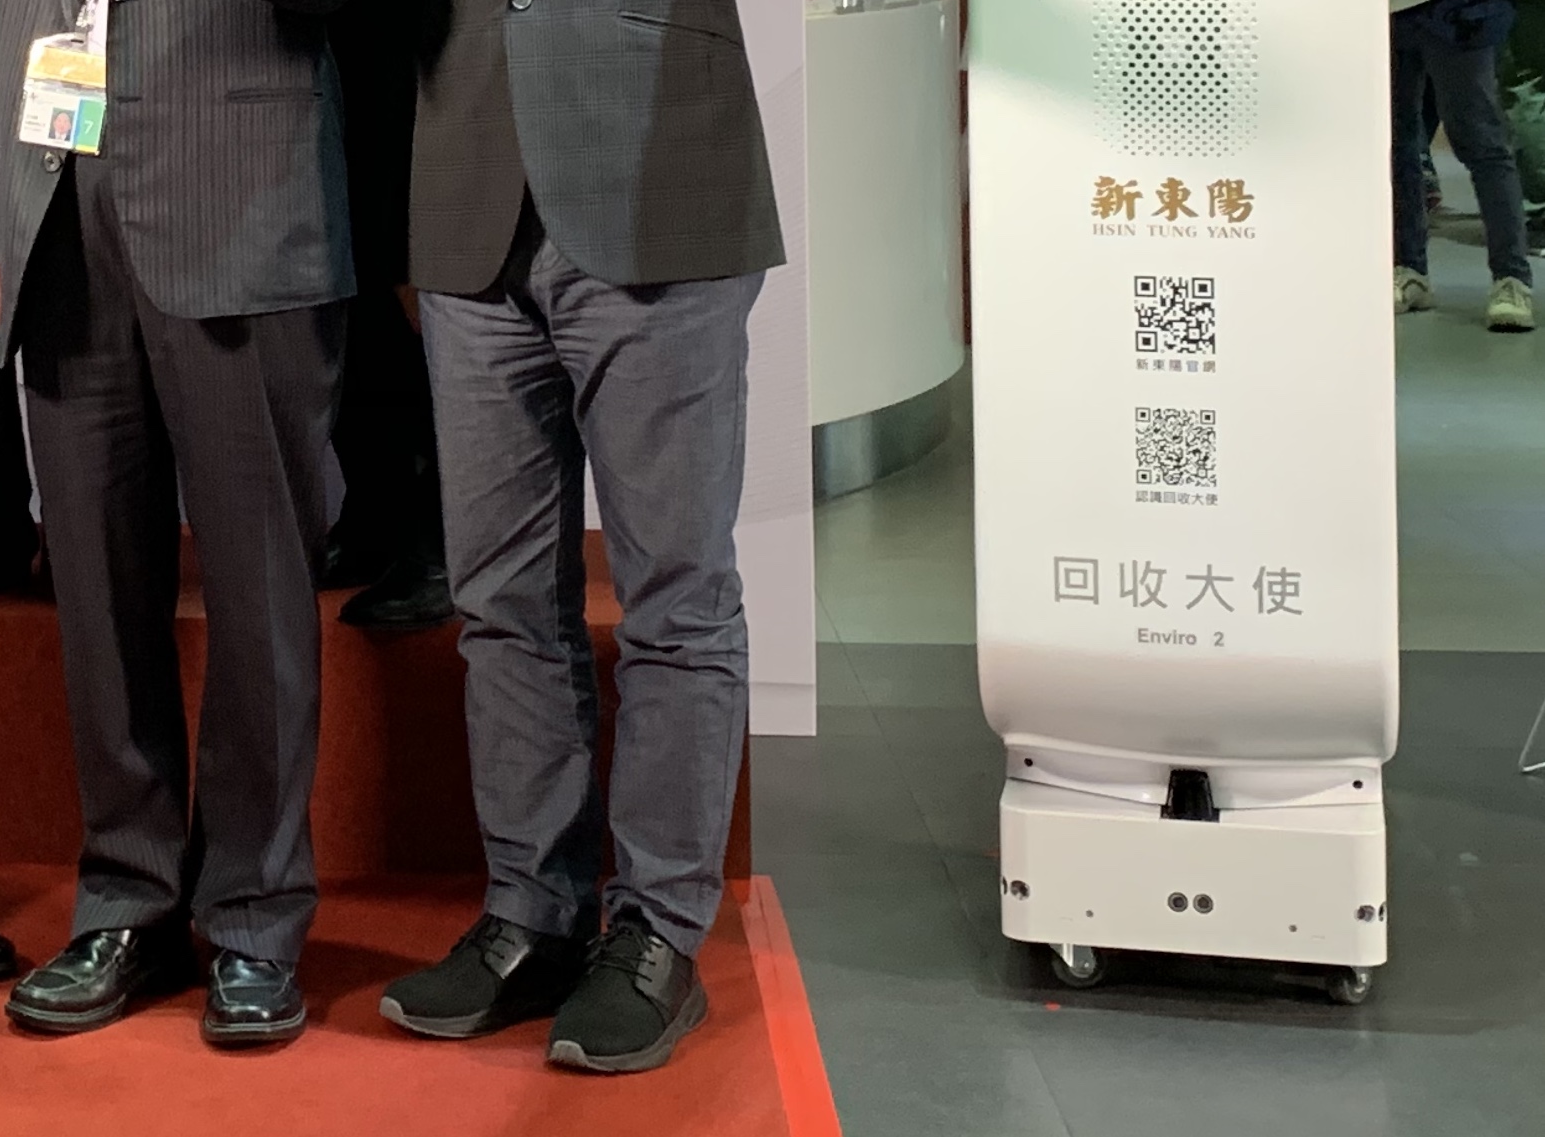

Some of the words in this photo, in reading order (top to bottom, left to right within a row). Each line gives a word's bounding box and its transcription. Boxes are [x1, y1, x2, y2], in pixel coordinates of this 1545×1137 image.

[1091, 175, 1255, 223] 新東陽
[1092, 223, 1136, 236] HSIN
[1146, 224, 1197, 238] TUNG
[1206, 226, 1256, 240] YANG
[1054, 556, 1302, 615] 回收大使
[1137, 628, 1197, 645] Enviro
[1213, 631, 1224, 647] 2
